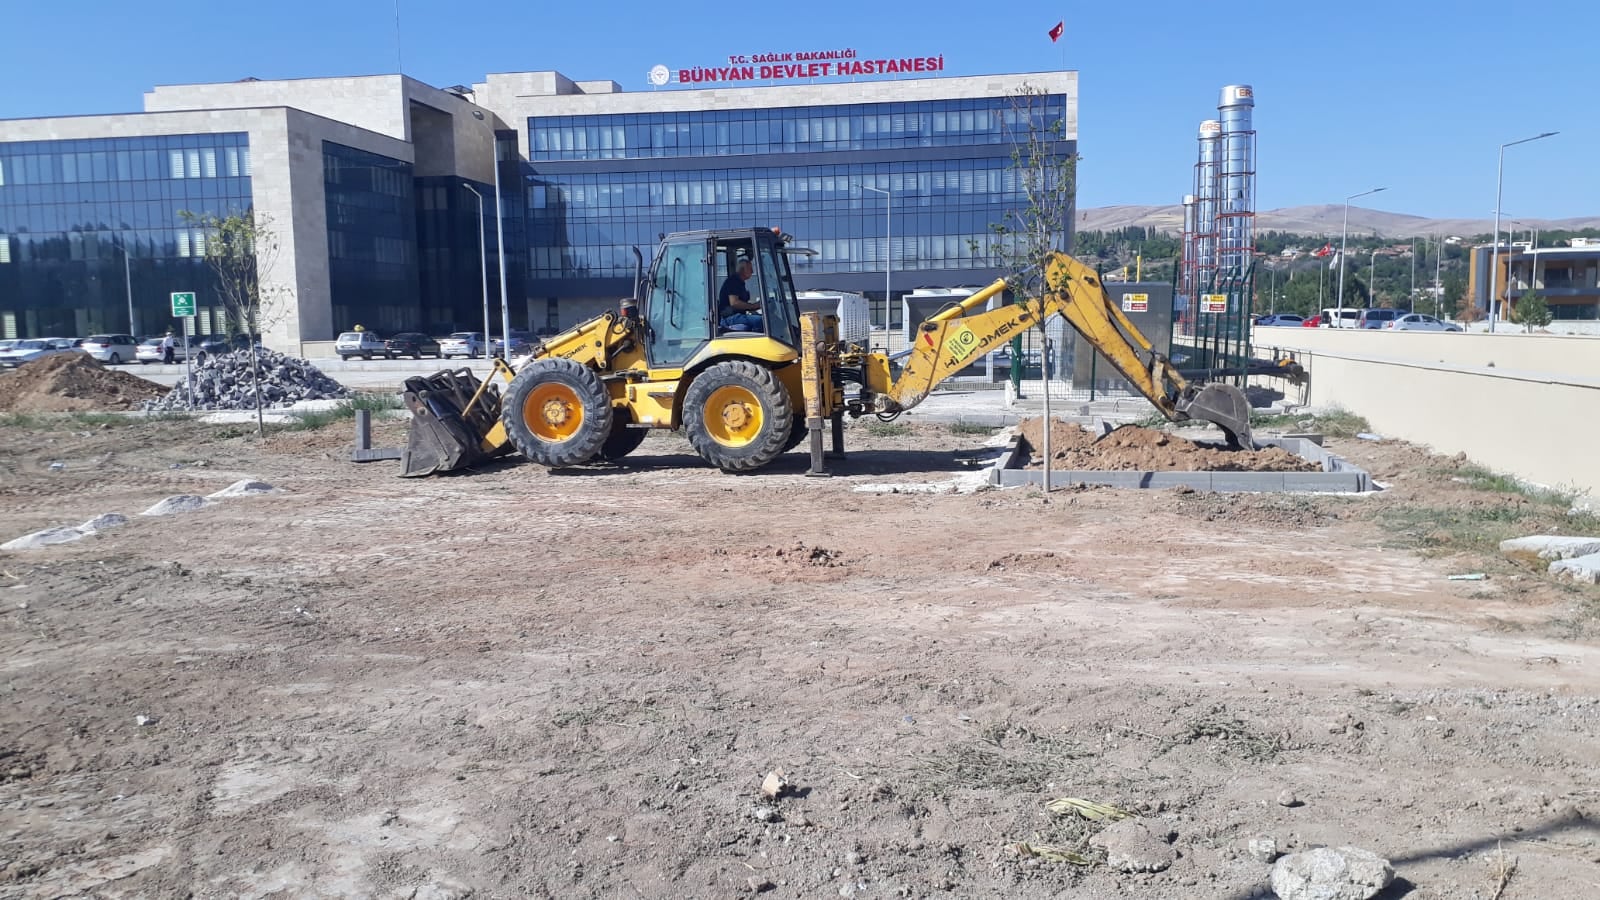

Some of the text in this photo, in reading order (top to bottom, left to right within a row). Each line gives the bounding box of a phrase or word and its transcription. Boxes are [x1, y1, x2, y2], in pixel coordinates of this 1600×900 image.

[679, 53, 944, 83] BÜNYAN DEVLET HASTANESİ
[729, 48, 856, 65] T.C. SAĞLIK BAKANLIĞI
